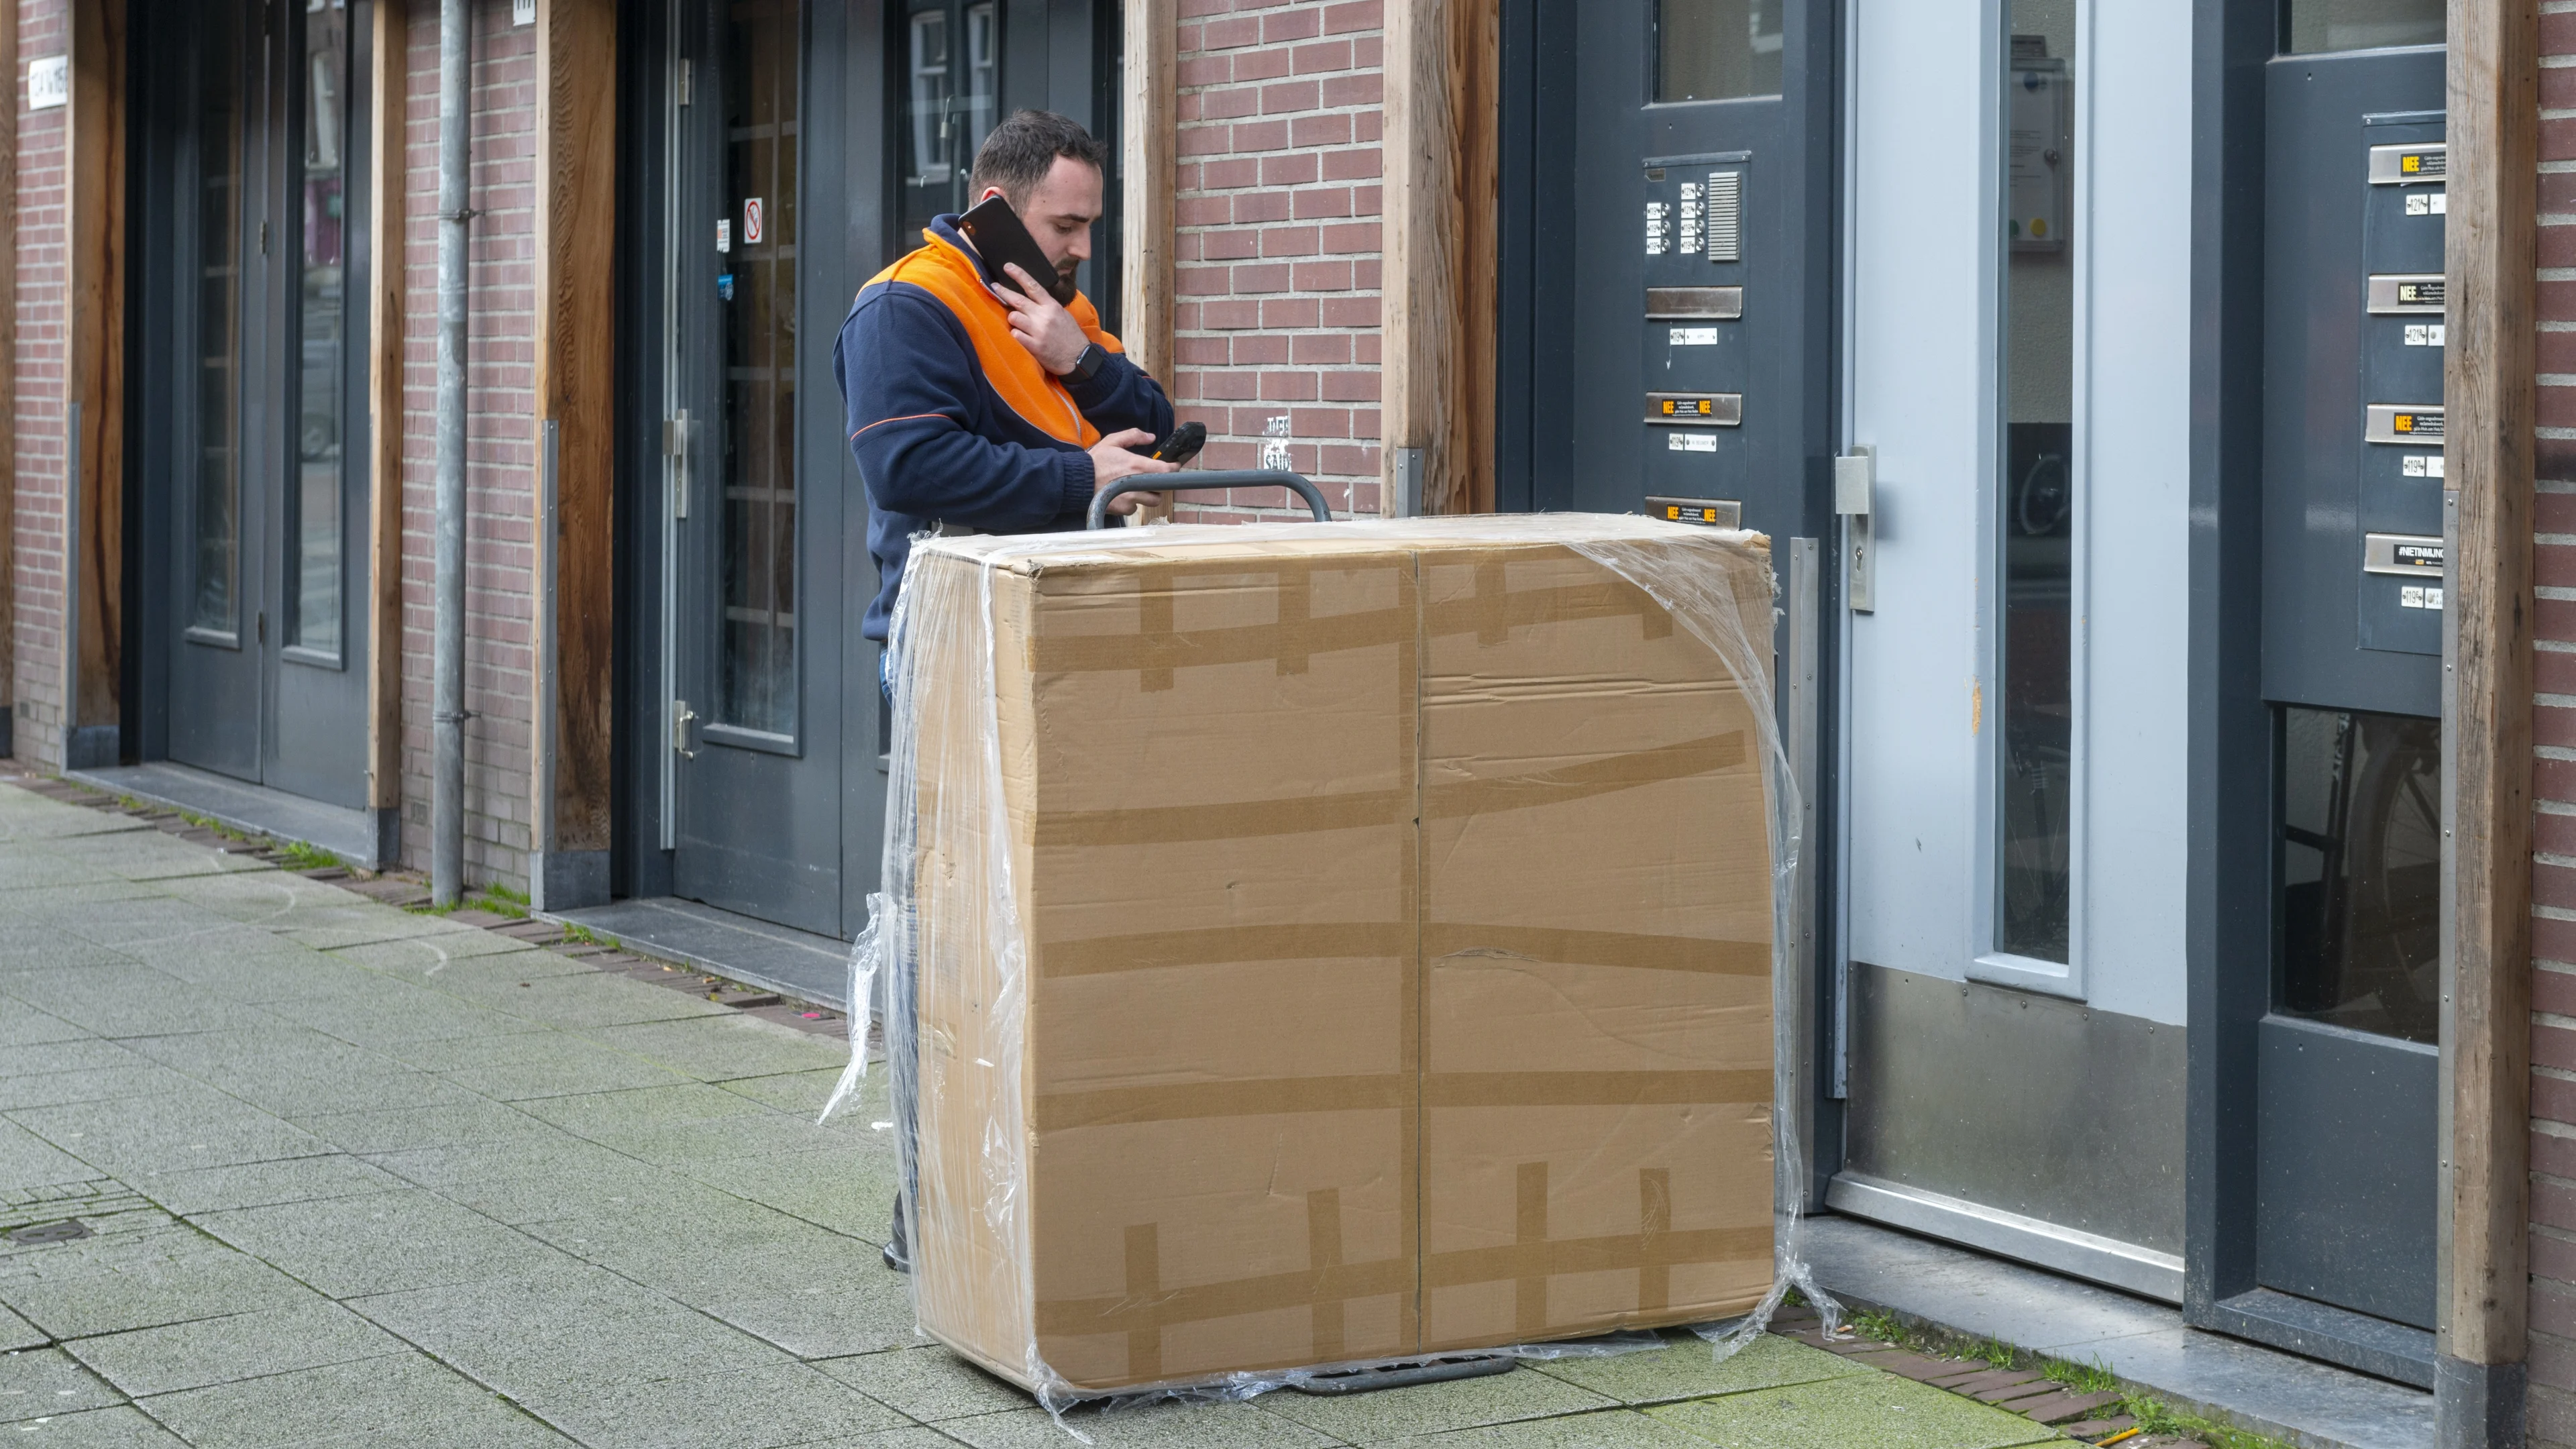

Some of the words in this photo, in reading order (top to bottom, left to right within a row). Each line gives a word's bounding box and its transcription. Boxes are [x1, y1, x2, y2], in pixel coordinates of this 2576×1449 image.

[2402, 156, 2419, 172] NEE
[2400, 286, 2416, 301] NEE
[1663, 400, 1674, 414] NEE
[1699, 400, 1711, 413] NEE
[2396, 416, 2412, 431] NEE
[1667, 506, 1678, 519] NEE
[1704, 508, 1715, 523] NEE
